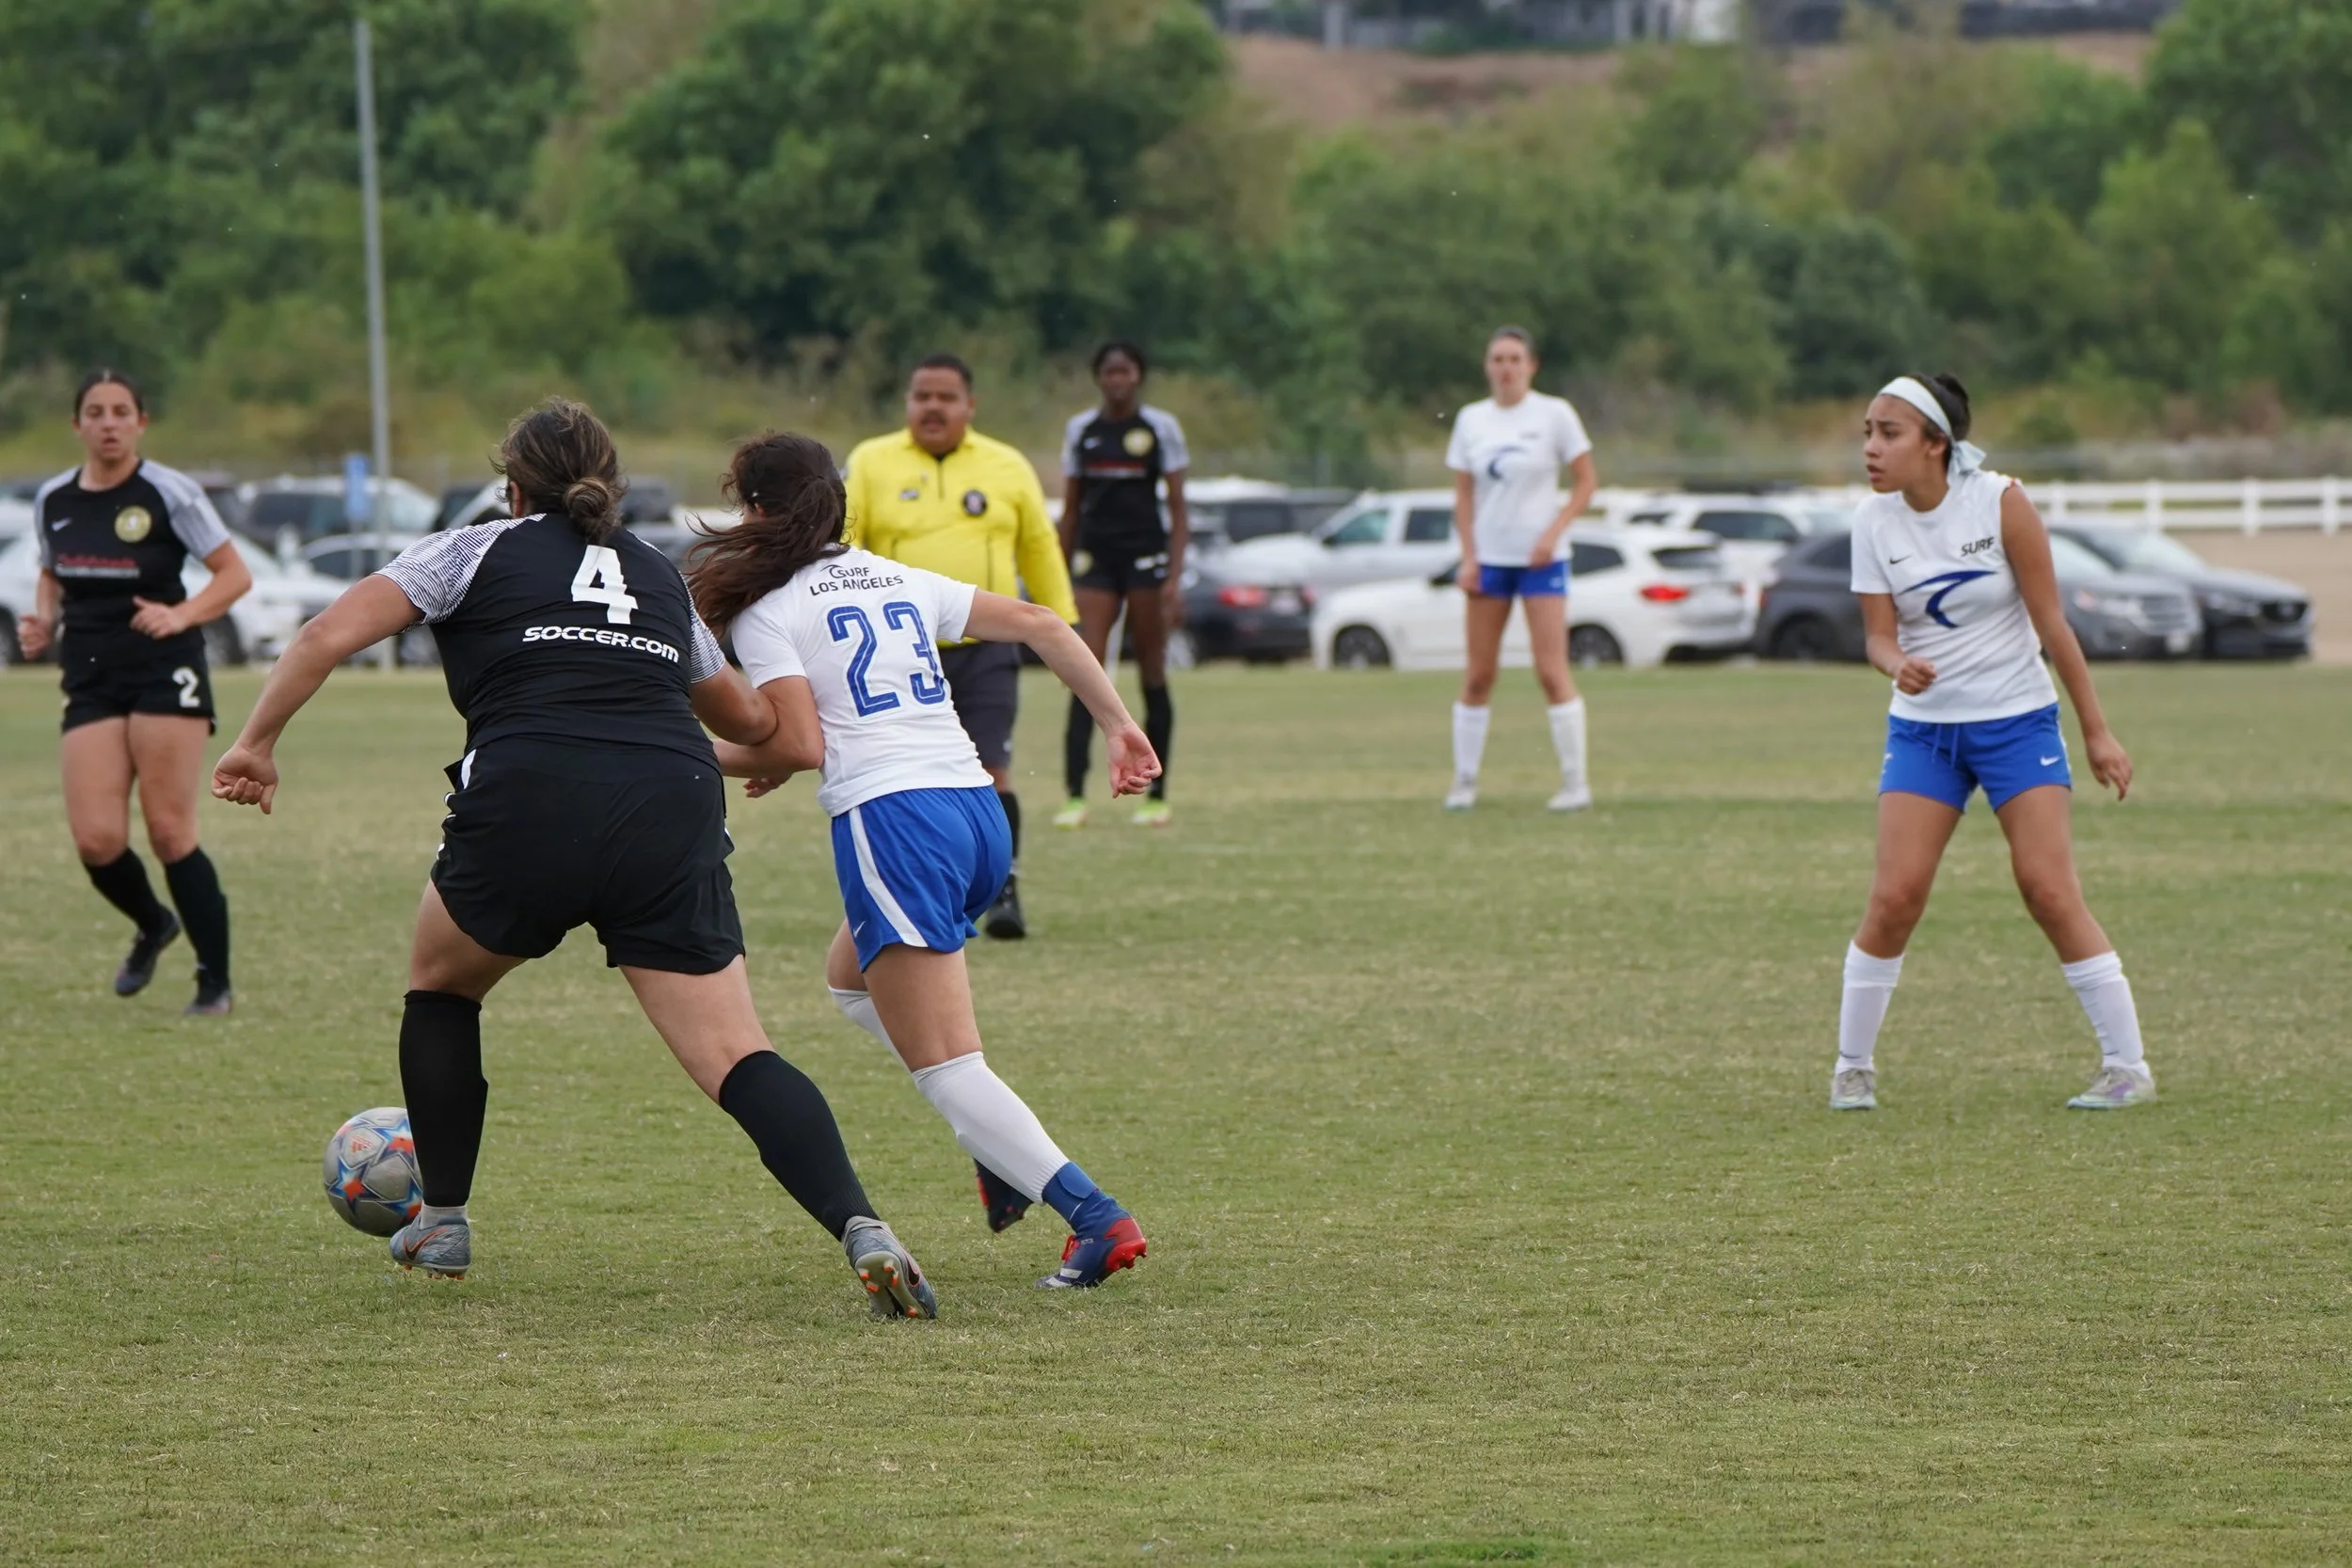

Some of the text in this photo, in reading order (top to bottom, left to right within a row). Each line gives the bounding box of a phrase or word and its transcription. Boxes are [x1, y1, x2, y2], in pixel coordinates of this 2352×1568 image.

[1961, 536, 1994, 557] SURF
[571, 545, 639, 625] 4
[809, 575, 904, 596] LOS ANGELES
[834, 566, 870, 578] SURF
[522, 626, 679, 662] SOCCER.COM
[827, 601, 946, 718] 23
[172, 667, 200, 708] 2
